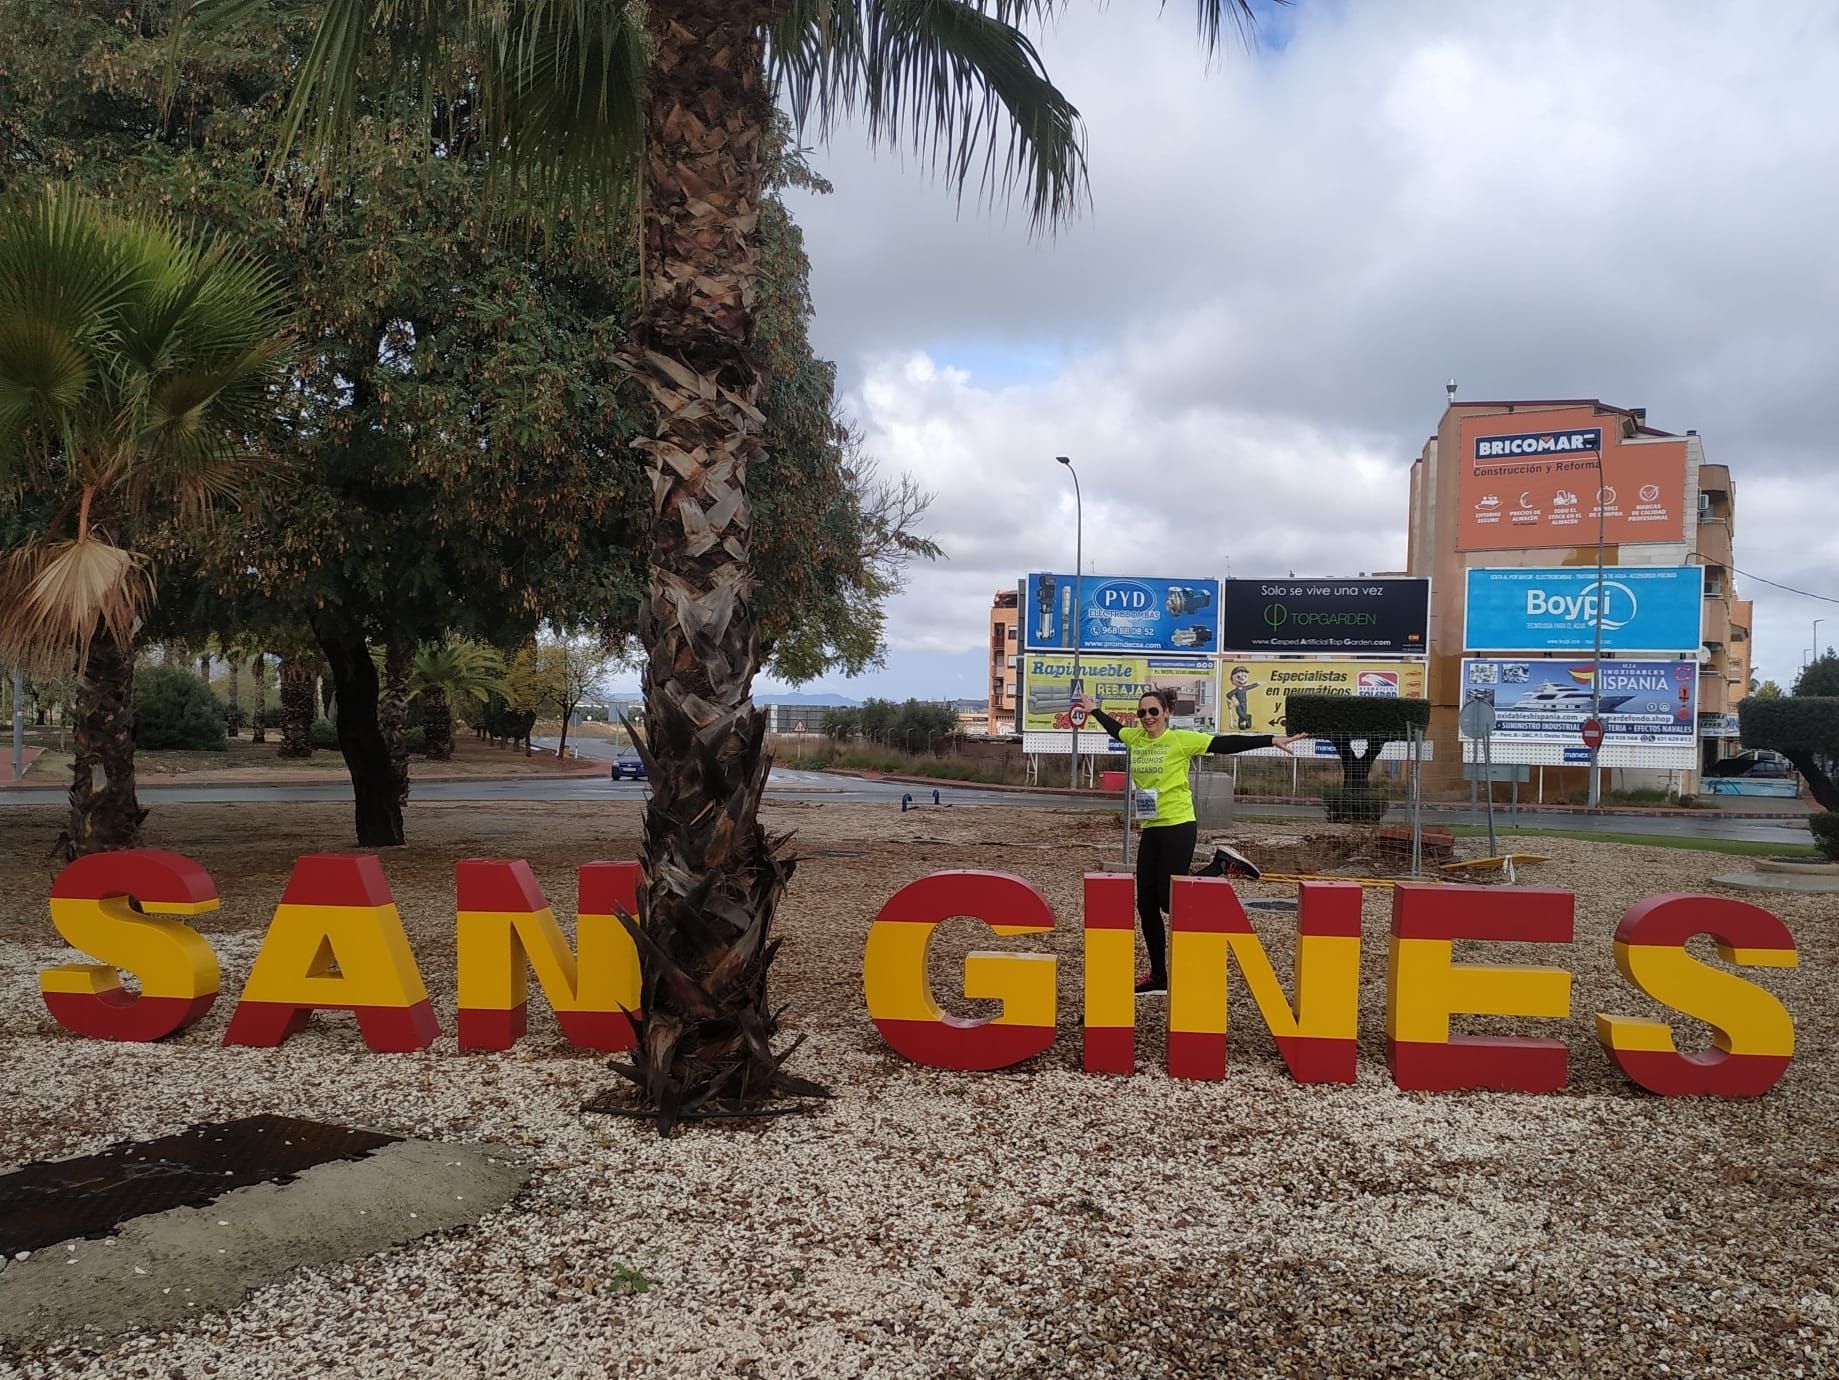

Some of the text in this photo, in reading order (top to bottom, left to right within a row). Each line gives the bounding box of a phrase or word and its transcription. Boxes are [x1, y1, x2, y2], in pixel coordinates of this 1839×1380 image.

[1473, 460, 1601, 477] Construcción y Reforma
[1261, 584, 1384, 596] Solo se vive una vez
[1105, 590, 1145, 608] PYD
[1527, 589, 1610, 620] Boypi
[1290, 612, 1377, 625] TOPGARDEN
[1144, 628, 1154, 636] 52
[1031, 661, 1133, 678] Rapimueble
[1270, 670, 1348, 683] Especialistas
[1097, 684, 1151, 696] REBAJAS
[1266, 685, 1352, 698] en neumáticos
[1273, 702, 1282, 713] y
[1072, 711, 1084, 720] 40
[1502, 722, 1541, 730] SUMINISTRO
[1542, 723, 1580, 731] INDUSTRIAL
[39, 848, 1799, 1098] SAN GINES
